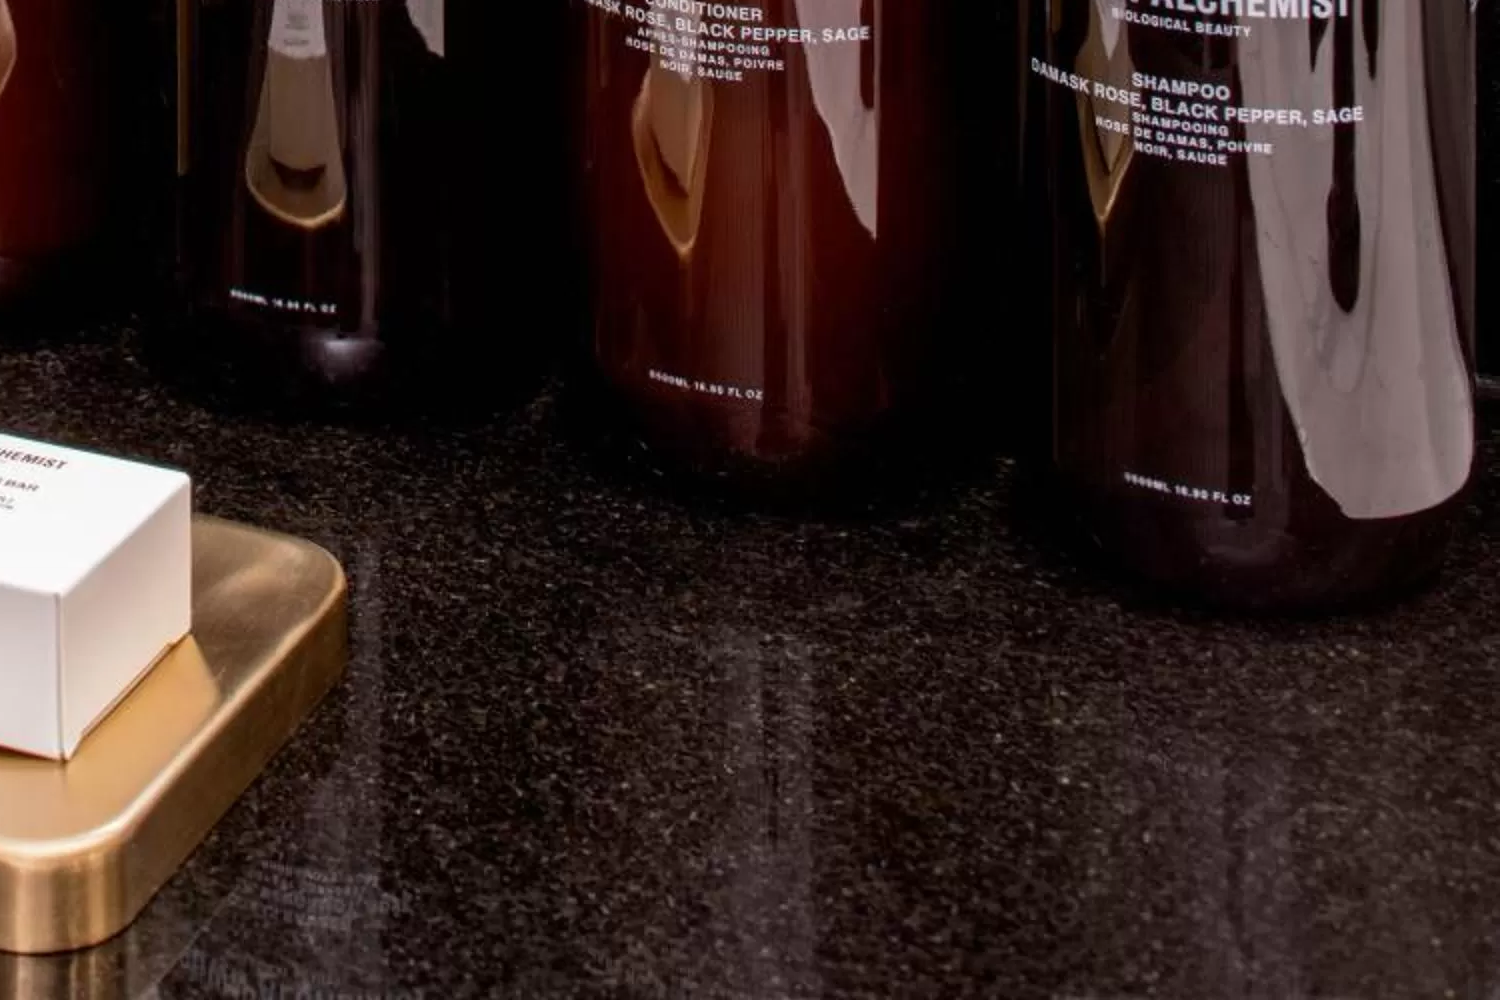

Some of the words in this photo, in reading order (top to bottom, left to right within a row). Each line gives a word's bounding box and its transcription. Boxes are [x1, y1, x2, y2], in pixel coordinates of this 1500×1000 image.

[625, 6, 671, 31] ROSE,
[676, 18, 735, 39] BLACK
[740, 27, 817, 44] PEPPER,
[821, 26, 870, 43] SAGE
[1112, 7, 1190, 33] BIOLOGICAL
[1195, 21, 1251, 37] BEAUTY
[625, 36, 655, 54] ROSE
[660, 44, 675, 57] DE
[733, 57, 784, 71] POIVRE
[698, 66, 743, 81] SAUGE
[1132, 72, 1231, 100] SHAMPOO
[1031, 57, 1090, 96] DAMASK
[1094, 82, 1147, 110] ROSE,
[1151, 96, 1217, 121] BLACK
[1224, 107, 1307, 127] PEPPER,
[1313, 106, 1364, 124] SAGE
[1095, 115, 1129, 135] ROSE
[1134, 126, 1150, 140] DE
[1156, 129, 1213, 150] DAMAS,
[1217, 140, 1272, 155] POIVRE
[1132, 111, 1229, 137] SHAMPOOING
[1134, 141, 1173, 160] NOIR,
[1177, 149, 1227, 166] SAUGE
[5, 479, 40, 492] BAR
